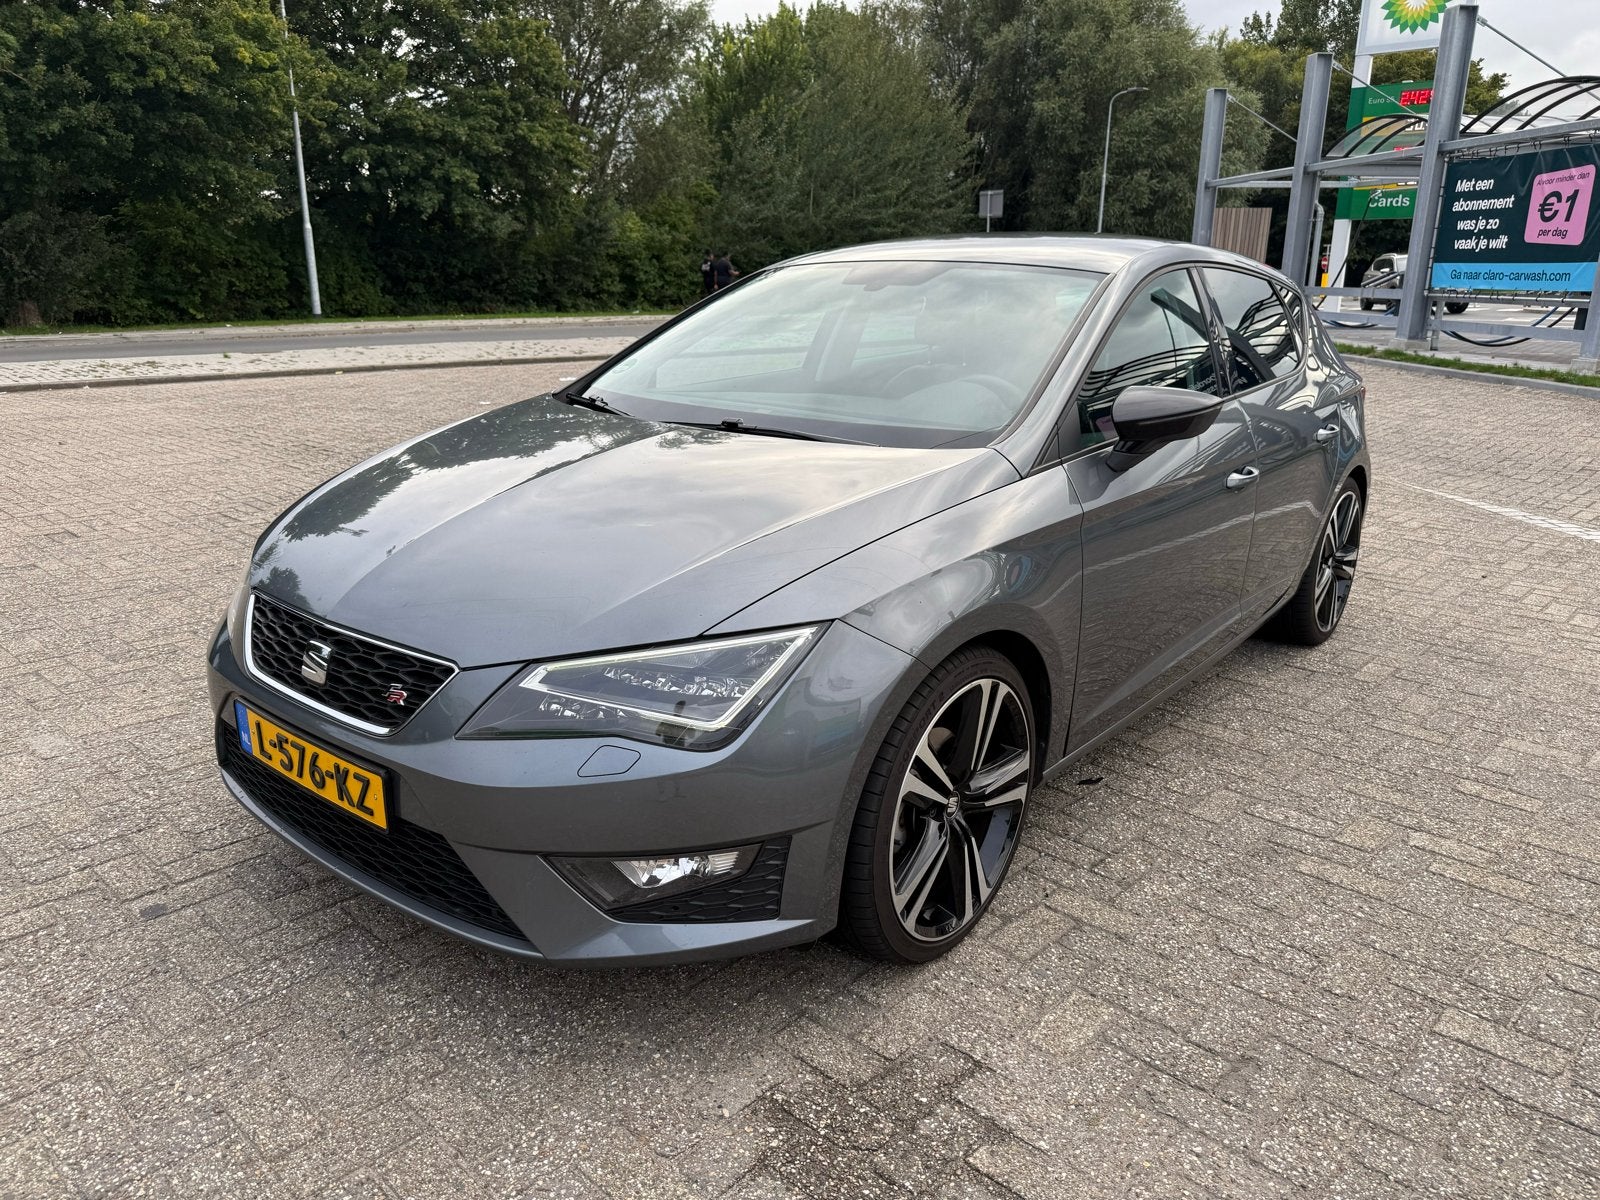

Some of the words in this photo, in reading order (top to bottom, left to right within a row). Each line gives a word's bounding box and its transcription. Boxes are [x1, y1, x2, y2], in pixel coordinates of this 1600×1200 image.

[1368, 97, 1385, 105] Euro
[1555, 172, 1576, 183] minder
[1577, 171, 1590, 180] dan
[1455, 179, 1475, 193] Met
[1475, 178, 1494, 191] een
[1452, 195, 1515, 212] abonnement
[1537, 189, 1580, 223] €1
[1457, 218, 1476, 231] was
[1475, 216, 1486, 233] je
[1486, 218, 1499, 230] zo
[1537, 229, 1551, 239] per
[1551, 227, 1568, 240] dag
[1454, 237, 1477, 250] vaak
[1475, 237, 1487, 252] je
[1488, 235, 1508, 249] wilt
[1450, 269, 1462, 280] Ga
[1463, 270, 1482, 281] naar
[1482, 269, 1571, 282] claro-carwash.com
[241, 730, 251, 746] NL
[254, 719, 374, 817] L-576-KZ
